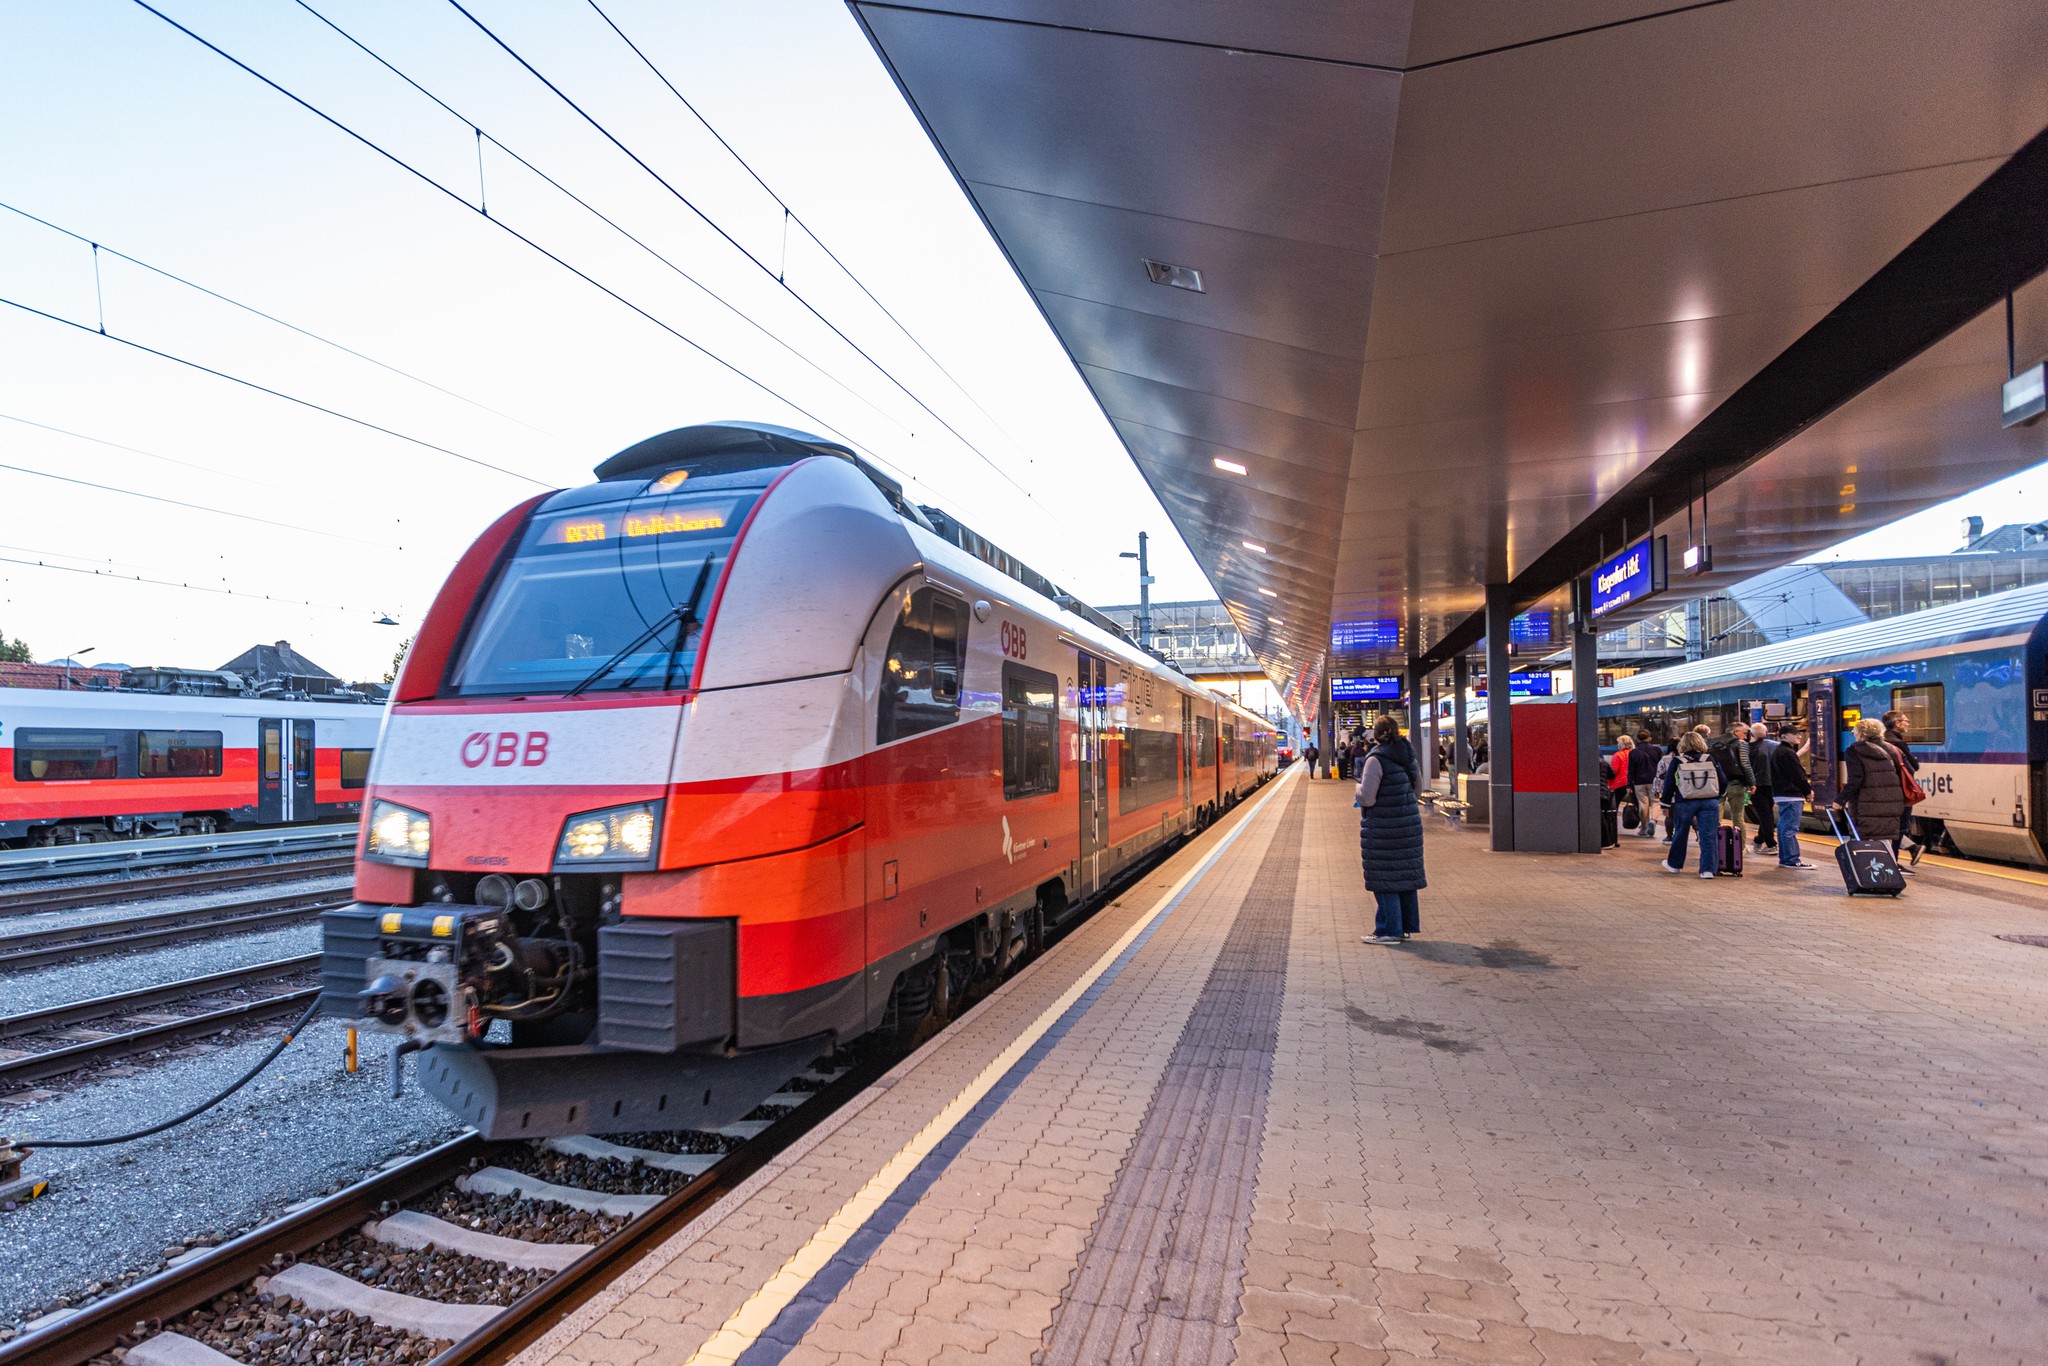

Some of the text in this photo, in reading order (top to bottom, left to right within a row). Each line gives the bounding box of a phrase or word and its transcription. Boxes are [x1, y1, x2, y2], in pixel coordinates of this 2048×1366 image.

[1598, 563, 1627, 593] Klagenfurt
[1000, 620, 1027, 660] ÖBB
[459, 731, 549, 768] ÖBB
